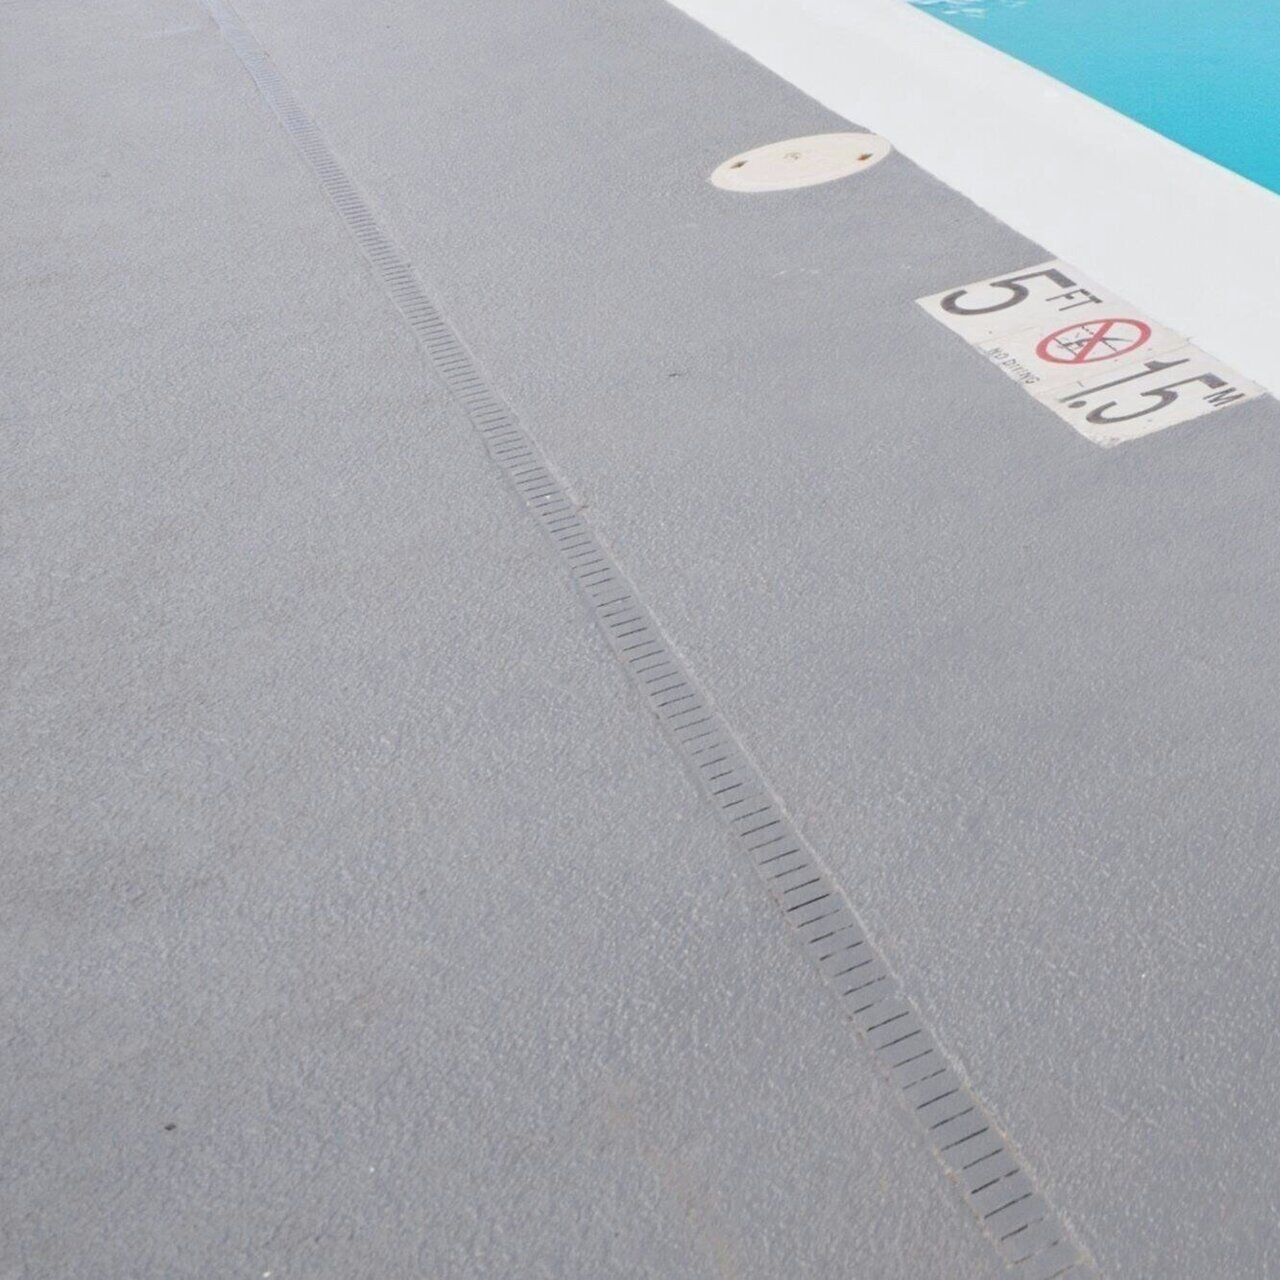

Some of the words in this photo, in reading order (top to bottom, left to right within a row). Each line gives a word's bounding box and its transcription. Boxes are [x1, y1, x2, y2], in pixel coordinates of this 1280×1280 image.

[940, 267, 1077, 316] 5
[1045, 288, 1103, 312] FT
[1203, 386, 1245, 407] M
